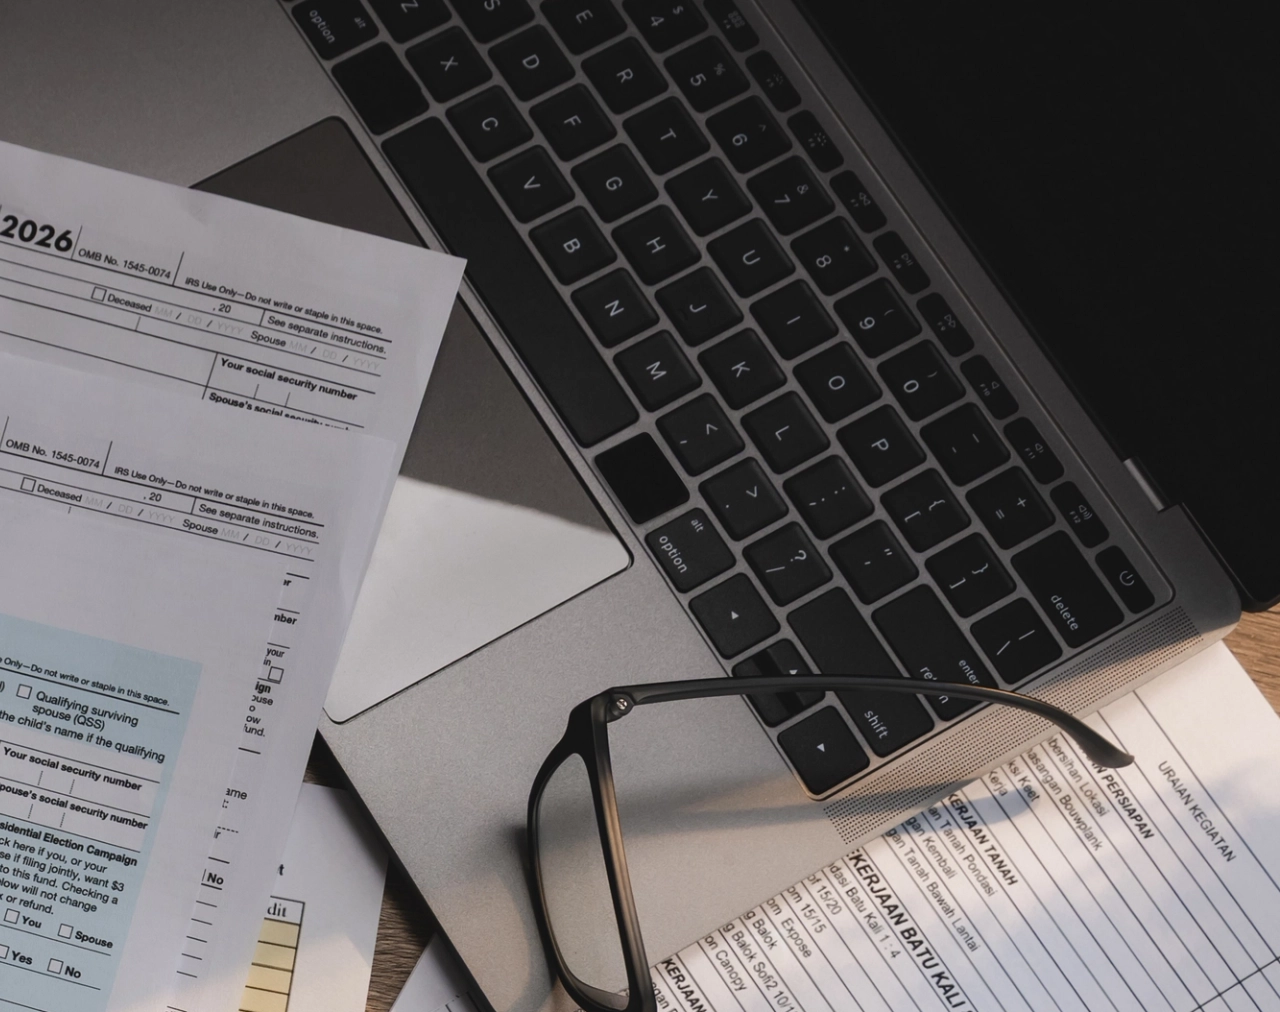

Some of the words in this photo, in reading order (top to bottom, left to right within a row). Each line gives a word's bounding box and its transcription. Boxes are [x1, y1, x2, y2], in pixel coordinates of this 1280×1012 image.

[308, 9, 336, 44] option
[353, 16, 366, 29] alt
[77, 247, 103, 262] OMB
[102, 253, 119, 267] No.
[122, 259, 171, 279] 1545-0074
[266, 314, 287, 328] See
[286, 321, 329, 339] separate
[329, 331, 386, 354] instructions.
[658, 535, 688, 573] option
[1050, 594, 1079, 631] delete
[863, 710, 888, 739] shift
[3, 745, 28, 761] Your
[28, 754, 60, 770] social
[59, 763, 102, 782] security
[102, 774, 143, 791] number
[1157, 760, 1194, 806] URAIAN
[1188, 803, 1237, 862] KEGIATAN
[21, 914, 42, 929] You
[11, 949, 33, 966] Yes
[63, 964, 82, 979] No
